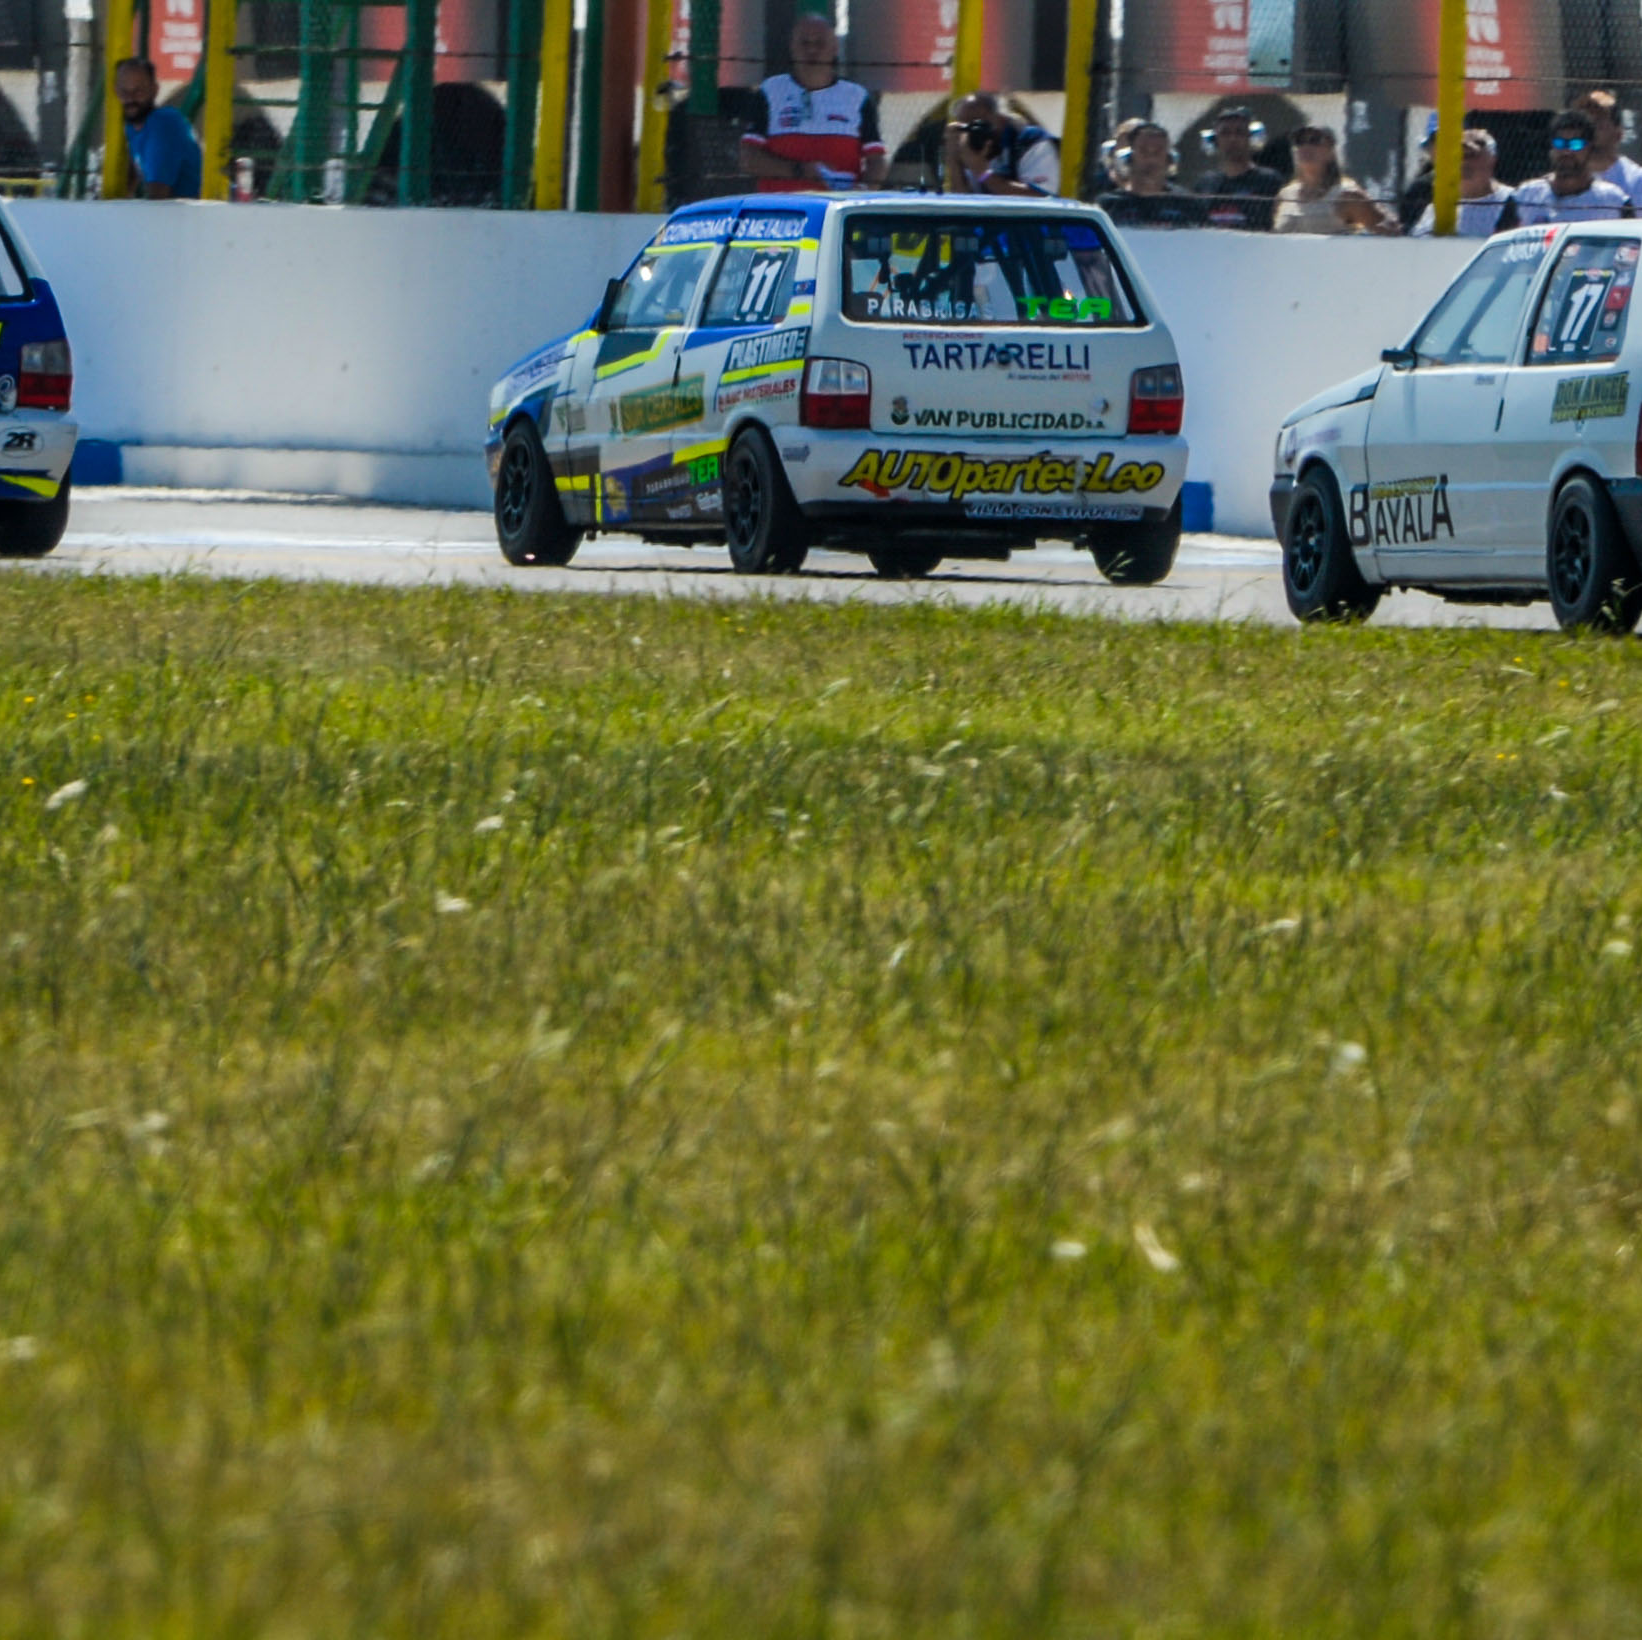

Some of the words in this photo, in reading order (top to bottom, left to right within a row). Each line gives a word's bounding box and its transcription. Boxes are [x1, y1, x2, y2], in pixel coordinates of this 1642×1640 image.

[740, 259, 784, 313] 11
[867, 298, 994, 321] PARABRISAS
[1017, 297, 1113, 321] TEA
[1560, 283, 1605, 342] 17
[904, 342, 1091, 372] TARTARELLI
[914, 409, 953, 427] VAN
[958, 410, 1085, 430] PUBLICIDAD
[689, 455, 719, 486] TEA
[1349, 472, 1455, 547] BAYALA
